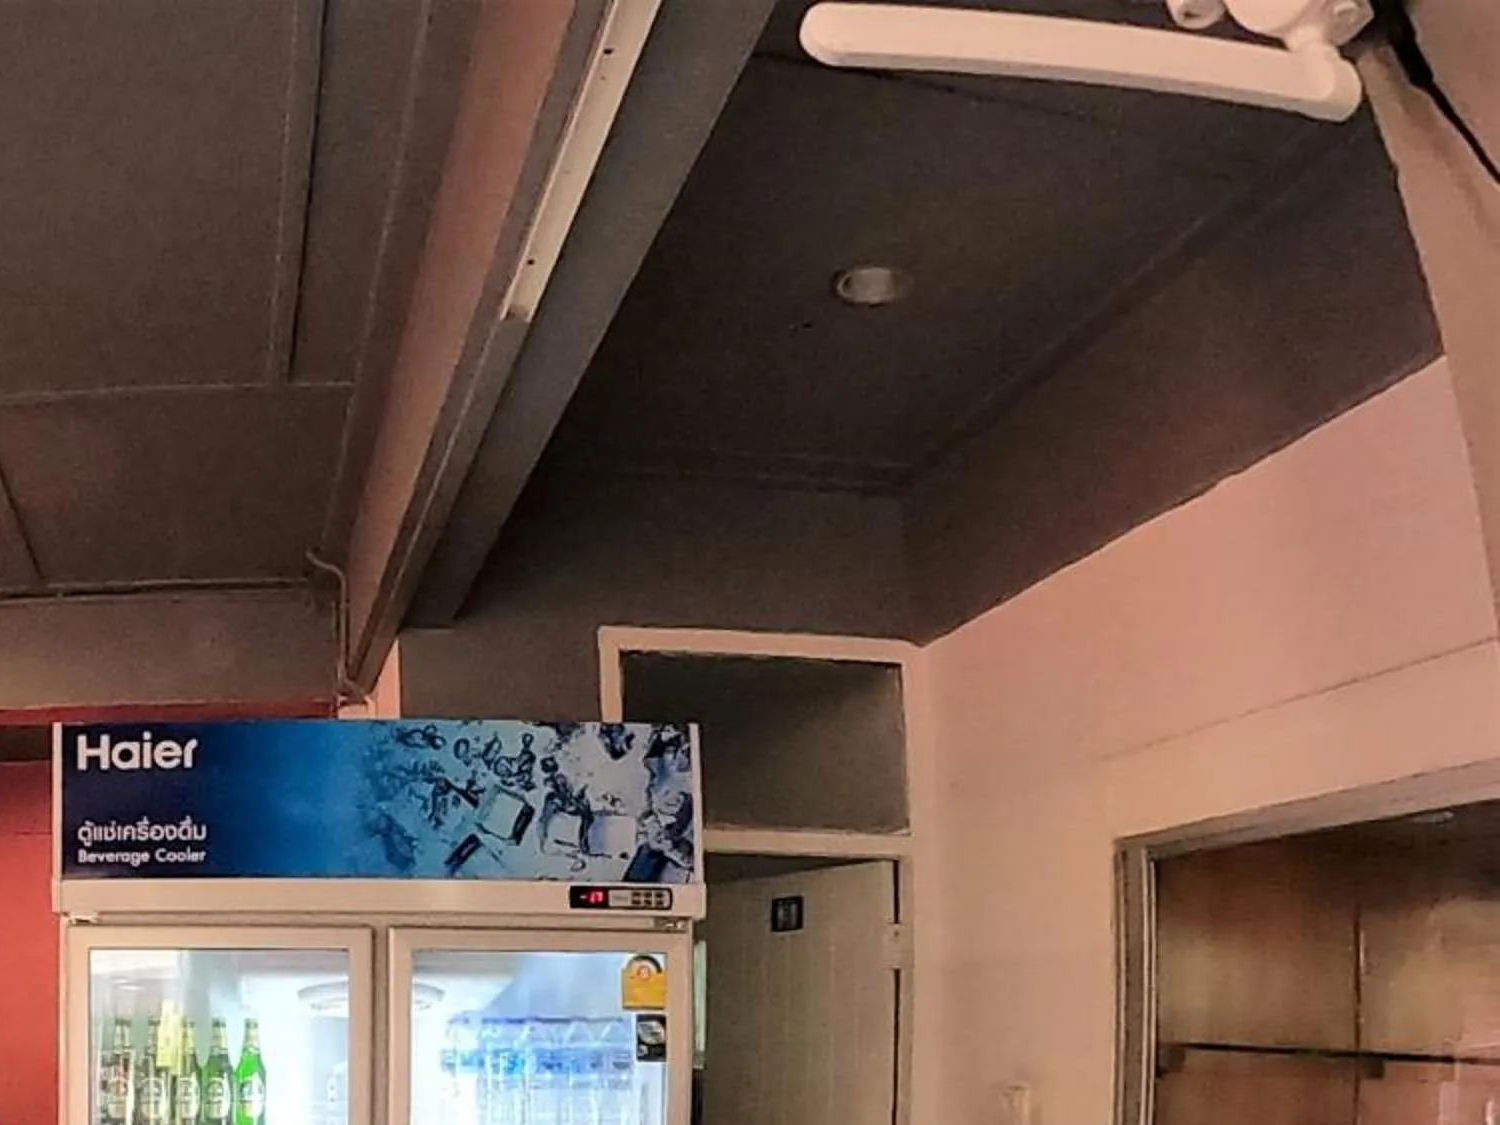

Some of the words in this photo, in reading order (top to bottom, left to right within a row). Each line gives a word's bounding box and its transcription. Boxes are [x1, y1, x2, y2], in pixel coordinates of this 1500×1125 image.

[77, 731, 198, 771] Haier
[77, 815, 207, 847] ตู้แช่เครื่องดื่ม
[77, 848, 150, 868] Beverage
[155, 846, 207, 863] Cooler
